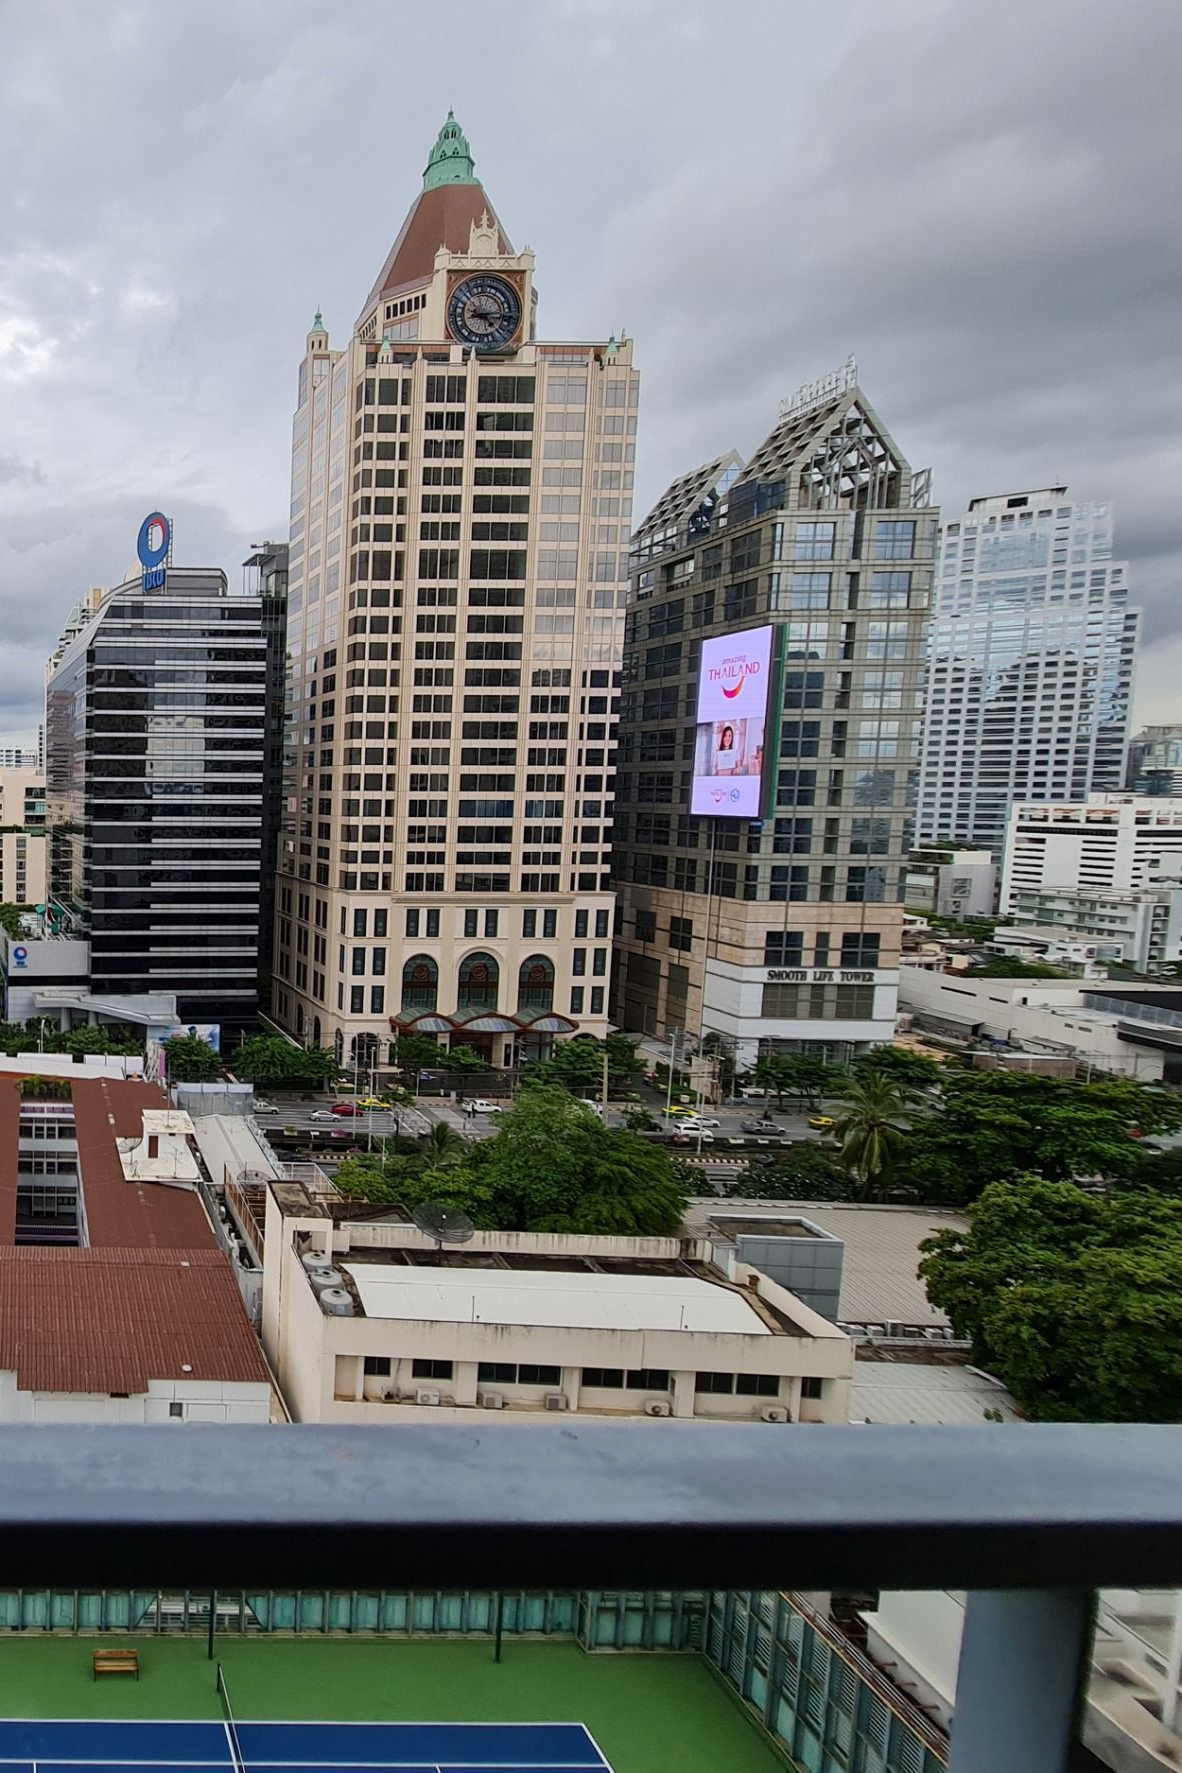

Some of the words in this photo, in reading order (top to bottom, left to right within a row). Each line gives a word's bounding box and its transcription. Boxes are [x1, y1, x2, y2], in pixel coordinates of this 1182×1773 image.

[708, 661, 761, 680] THAILAND
[767, 970, 807, 981] SMOOTH
[813, 971, 834, 981] LIFE
[840, 971, 875, 982] TOWER
